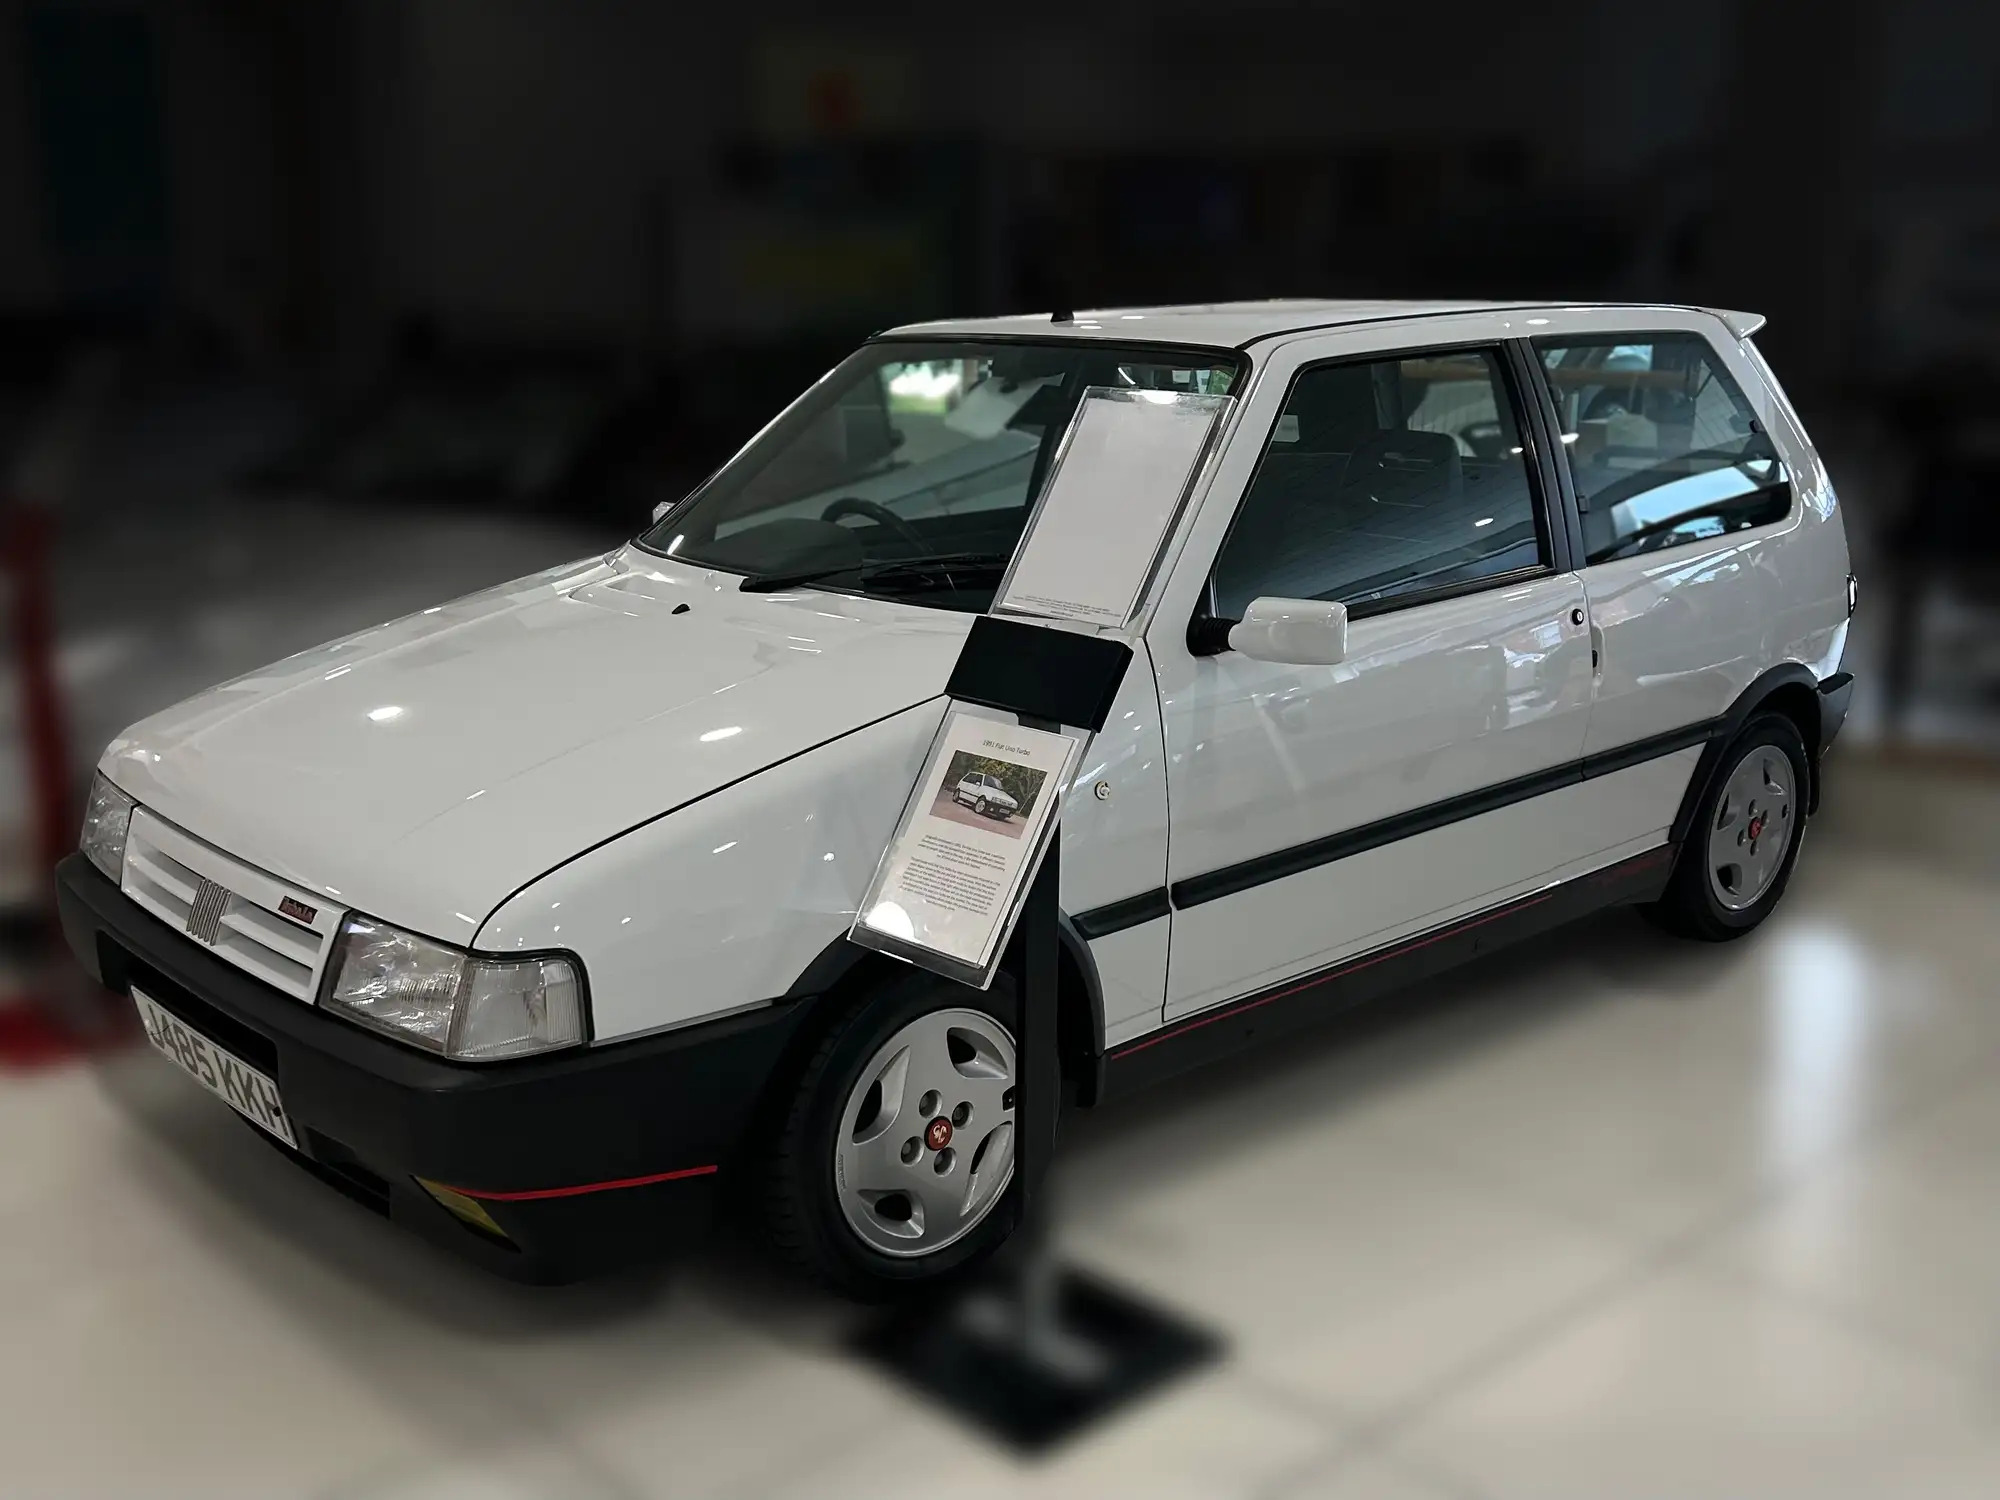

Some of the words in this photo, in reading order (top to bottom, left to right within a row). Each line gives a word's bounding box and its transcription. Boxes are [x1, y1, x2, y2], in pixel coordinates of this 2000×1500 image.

[994, 742, 1005, 750] Fiat
[1005, 744, 1016, 753] Uno
[1016, 747, 1031, 756] Turbo
[147, 1003, 218, 1089] J485
[213, 1050, 290, 1138] KKH
